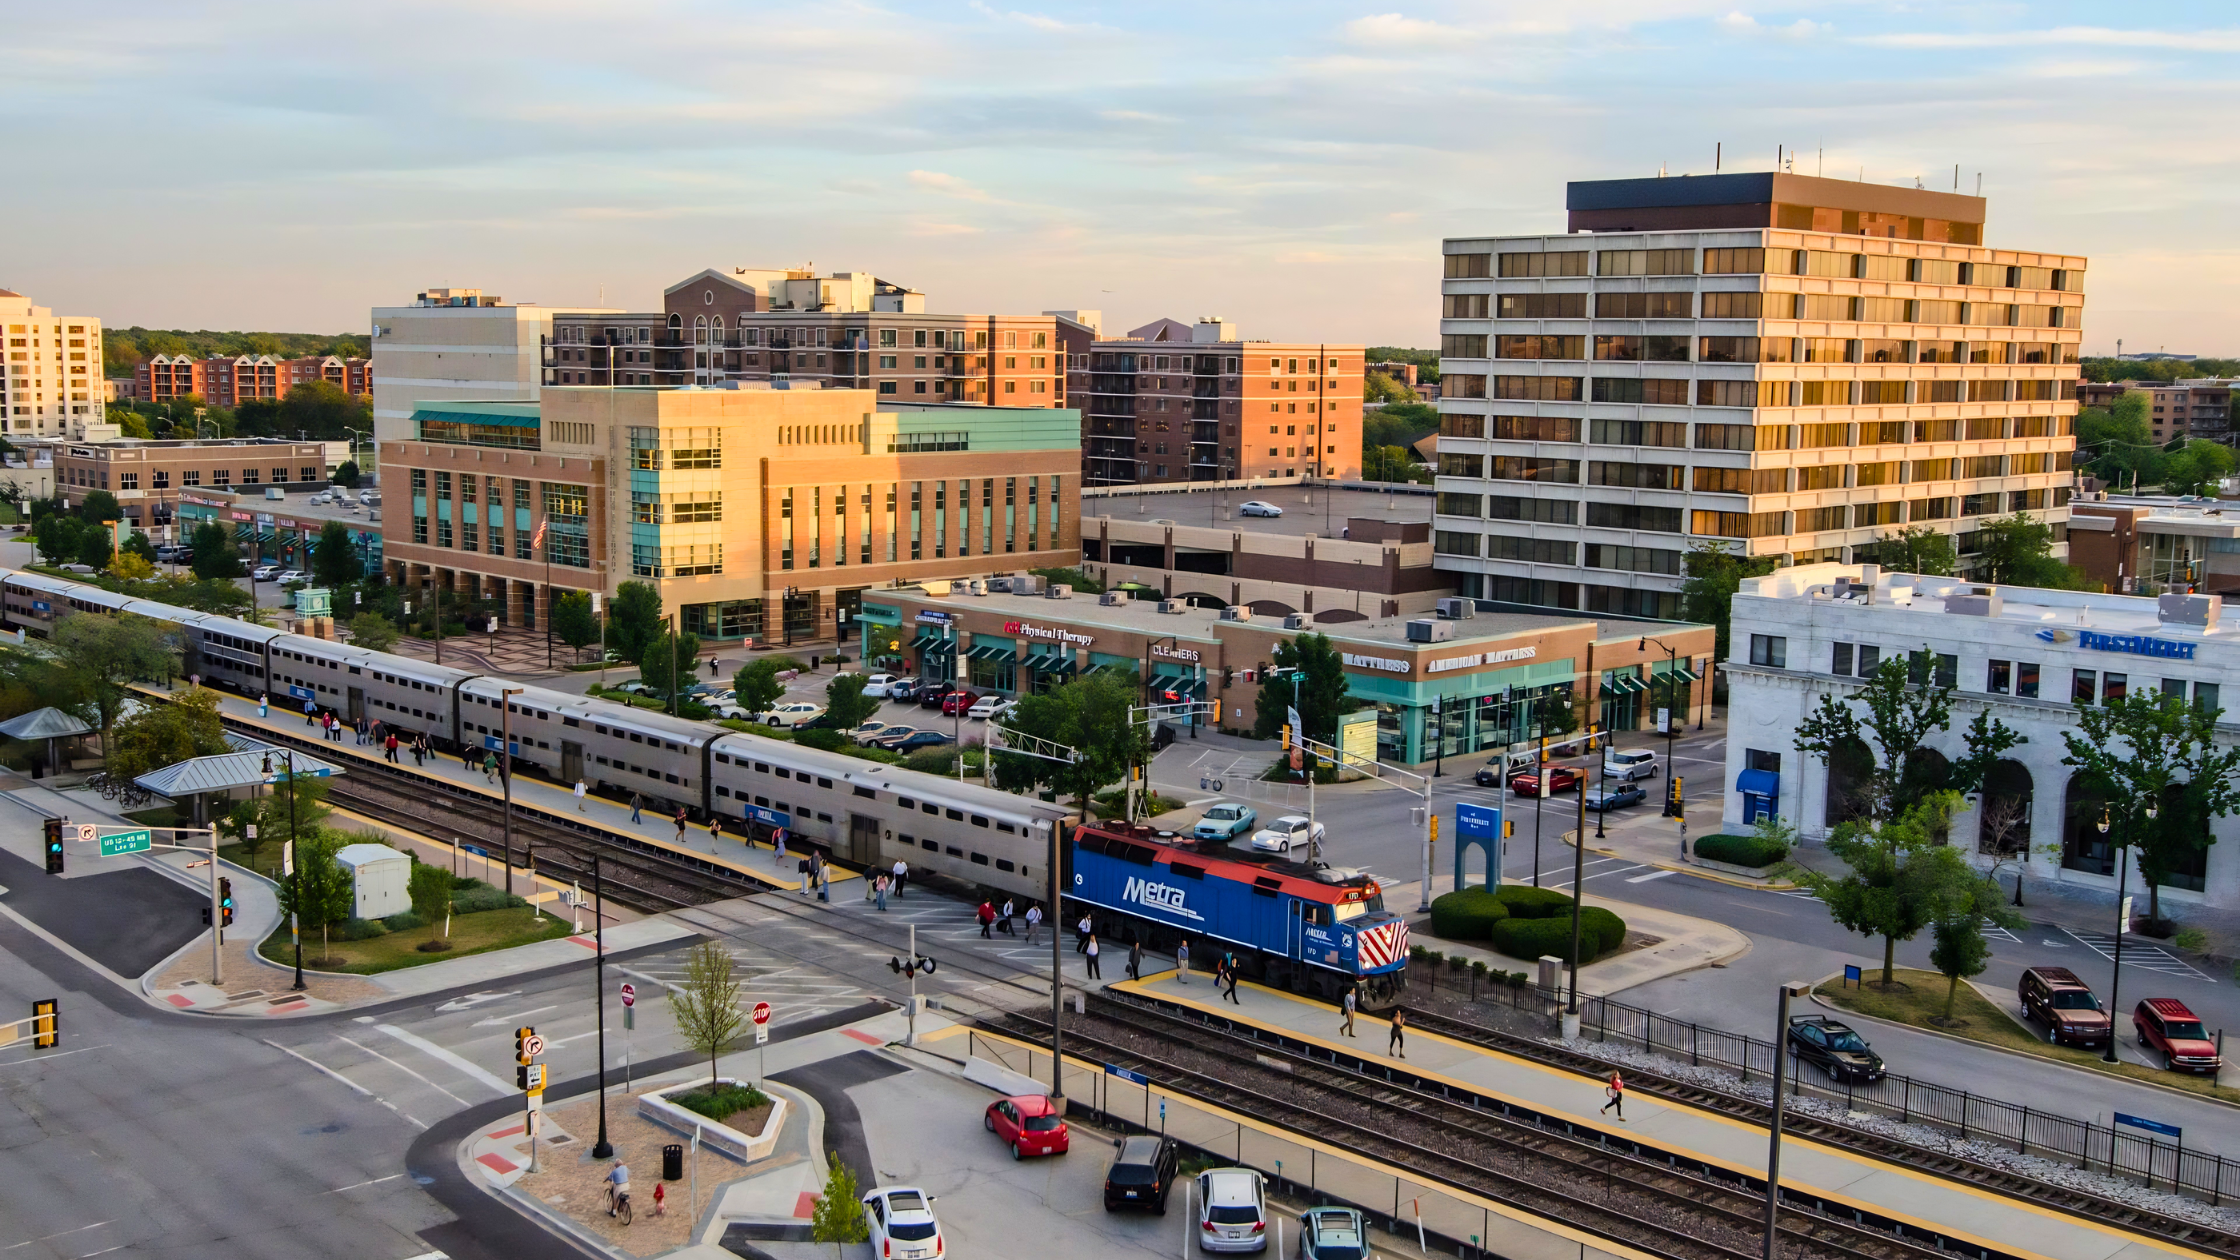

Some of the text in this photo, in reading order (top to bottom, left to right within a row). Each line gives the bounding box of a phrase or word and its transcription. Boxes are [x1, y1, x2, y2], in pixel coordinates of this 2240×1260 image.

[1020, 623, 1056, 638] Physical
[1057, 628, 1093, 646] Therapy
[1122, 876, 1186, 908] Metra
[753, 1006, 770, 1020] STOP
